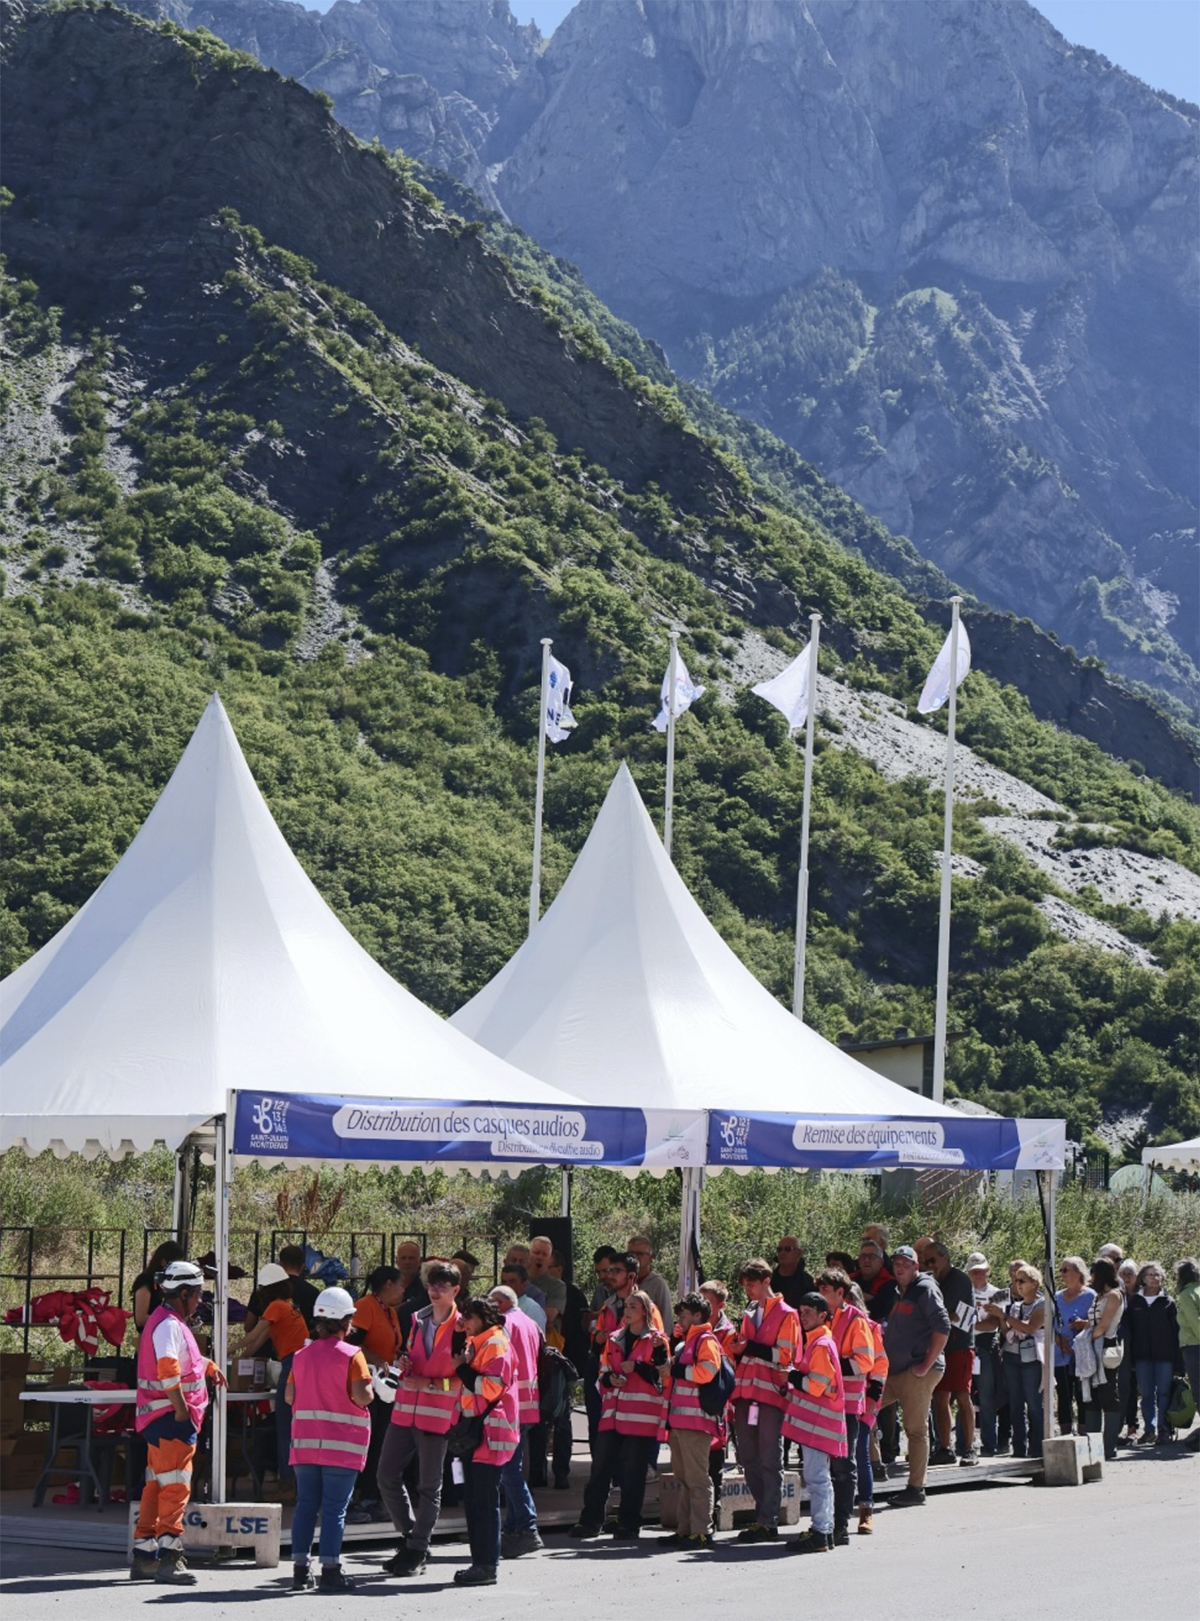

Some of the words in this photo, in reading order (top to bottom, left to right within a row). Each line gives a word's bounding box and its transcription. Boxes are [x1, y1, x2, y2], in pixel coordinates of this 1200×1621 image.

[273, 1100, 285, 1111] 12
[272, 1111, 282, 1122] 13
[738, 1117, 747, 1127] 12
[273, 1122, 283, 1133] 14
[346, 1109, 440, 1133] Distribution
[443, 1111, 470, 1133] des
[473, 1116, 530, 1140] casques
[532, 1115, 580, 1137] audios
[736, 1127, 745, 1137] 13
[802, 1124, 845, 1144] Remise
[847, 1124, 866, 1144] des
[867, 1124, 937, 1149] équipements
[735, 1136, 744, 1146] 14
[721, 1483, 740, 1497] 200
[226, 1516, 268, 1535] LSE
